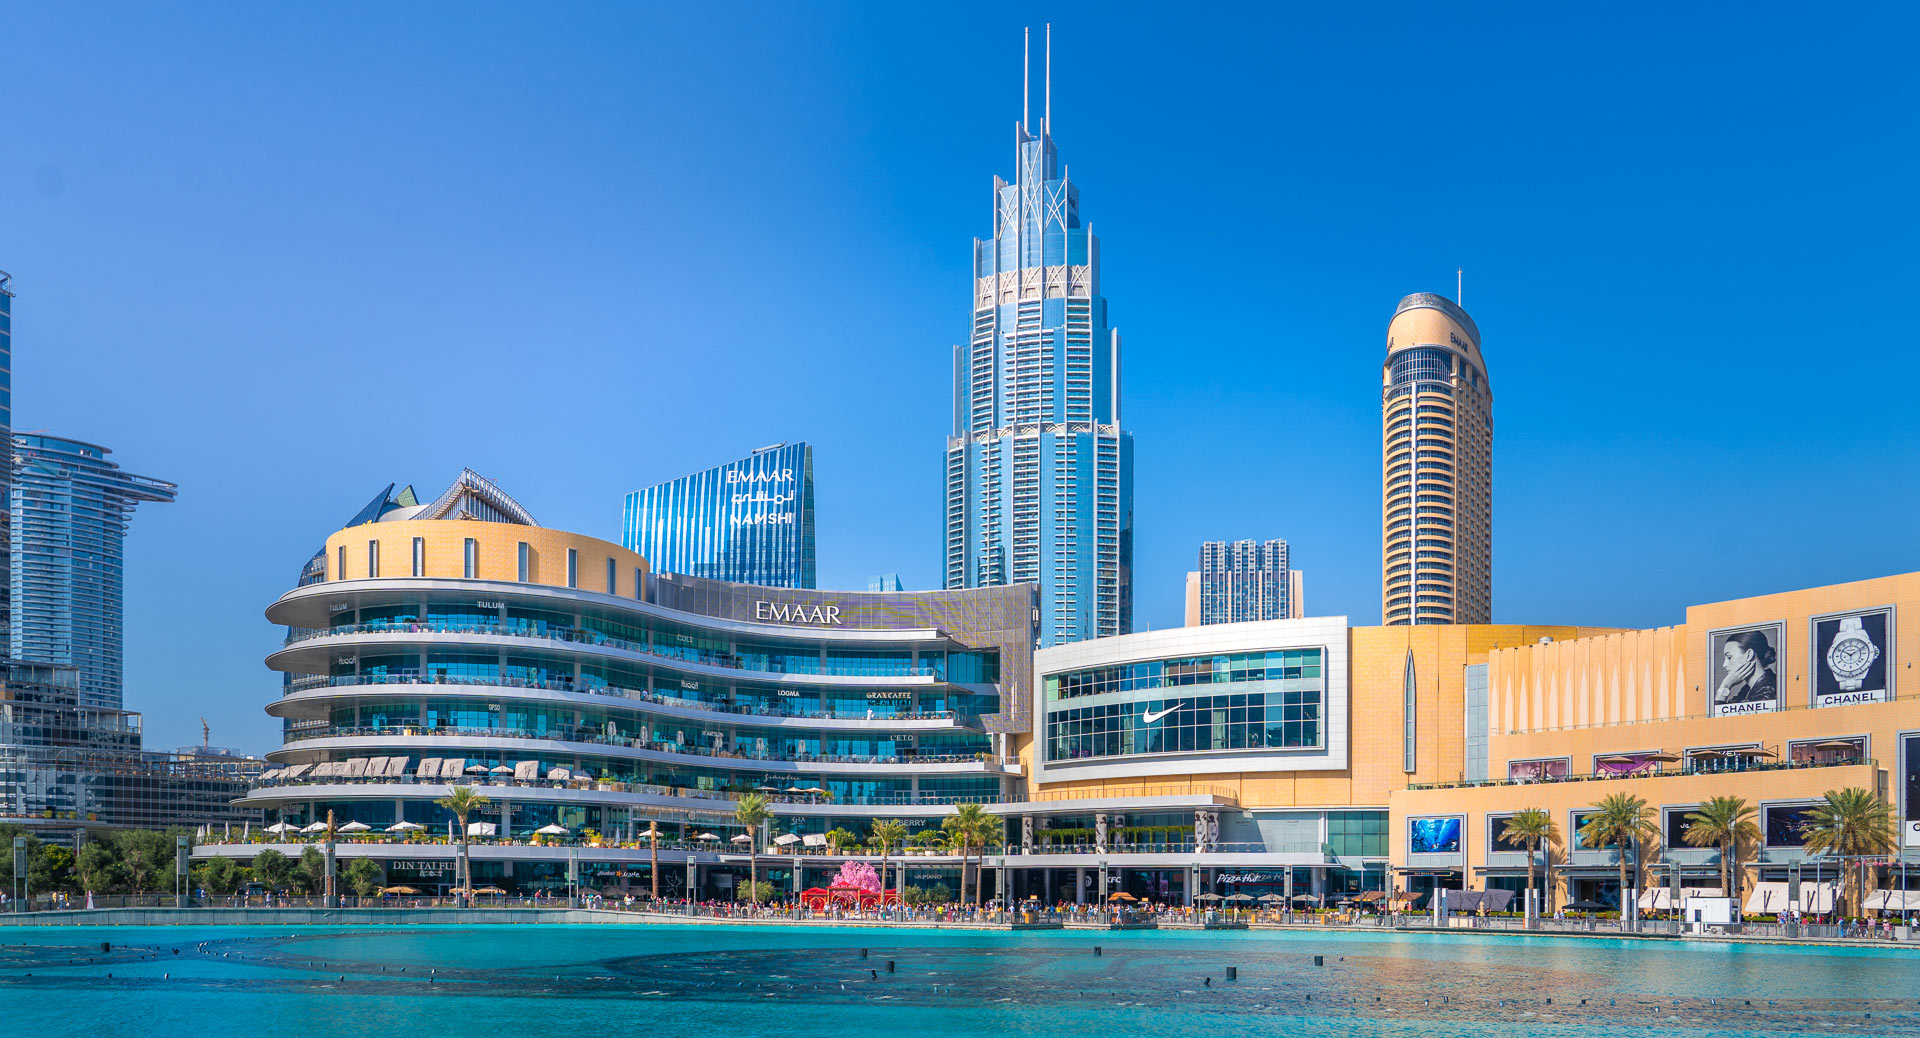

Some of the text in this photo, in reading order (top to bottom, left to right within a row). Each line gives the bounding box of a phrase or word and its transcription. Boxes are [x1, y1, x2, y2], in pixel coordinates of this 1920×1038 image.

[728, 469, 794, 484] EMAAR
[730, 512, 792, 526] NAMSHI
[329, 603, 348, 611] TULUM
[477, 601, 505, 610] TULUM
[756, 601, 842, 625] EMAAR
[1825, 692, 1878, 705] CHANEL
[1721, 702, 1769, 714] CHANEL
[393, 861, 414, 870] DIN
[418, 861, 436, 870] TAI
[1107, 876, 1121, 884] KFC
[1216, 873, 1242, 884] Pizza
[1242, 873, 1258, 883] Hut
